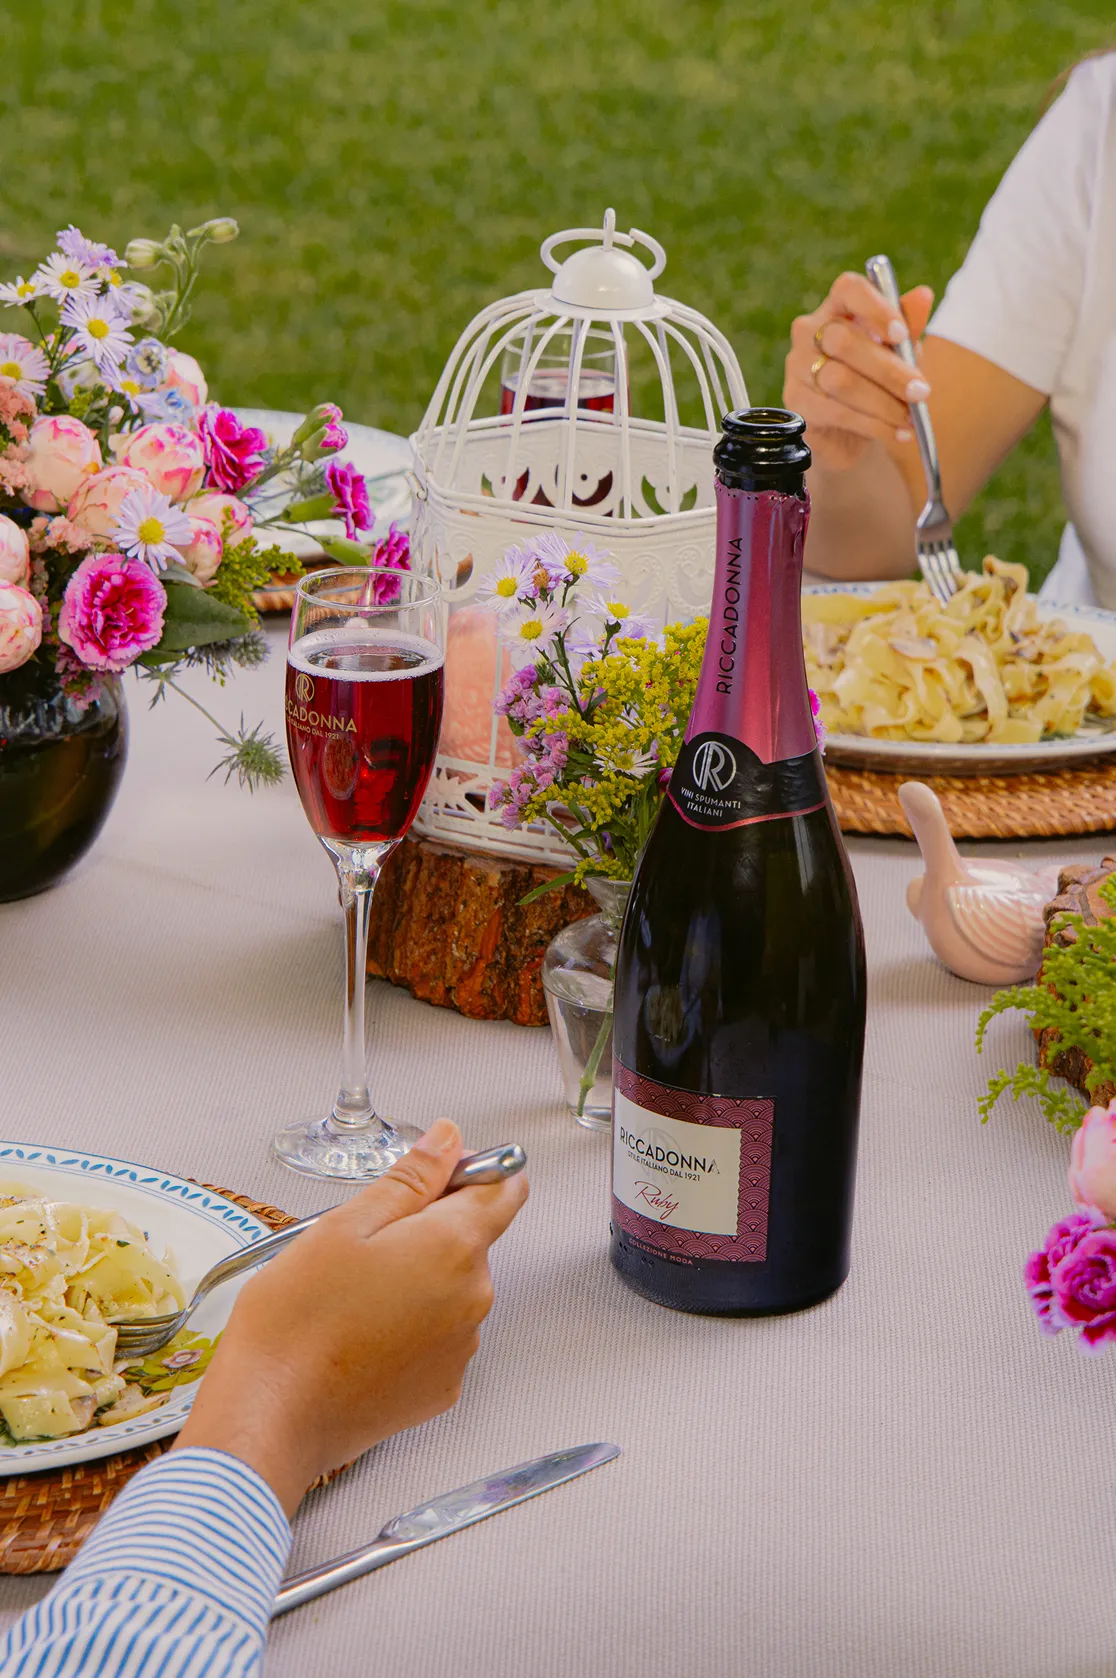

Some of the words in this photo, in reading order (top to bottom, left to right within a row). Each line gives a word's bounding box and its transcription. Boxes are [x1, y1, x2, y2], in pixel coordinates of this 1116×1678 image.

[716, 537, 743, 694] RICCADONNA
[285, 696, 357, 733] CADONNA
[325, 731, 340, 740] 1921
[681, 787, 694, 799] VINI
[694, 794, 741, 809] SPUMANTI
[687, 801, 723, 817] ITALIANI
[620, 1126, 720, 1175] RICCADONNA
[628, 1150, 640, 1162] STILE
[640, 1158, 669, 1174] ITALIANO
[669, 1168, 683, 1178] DAL
[684, 1172, 701, 1182] 1921
[634, 1180, 680, 1221] Ruby
[628, 1238, 667, 1259] COLLEZIONE
[669, 1254, 693, 1265] MODA
